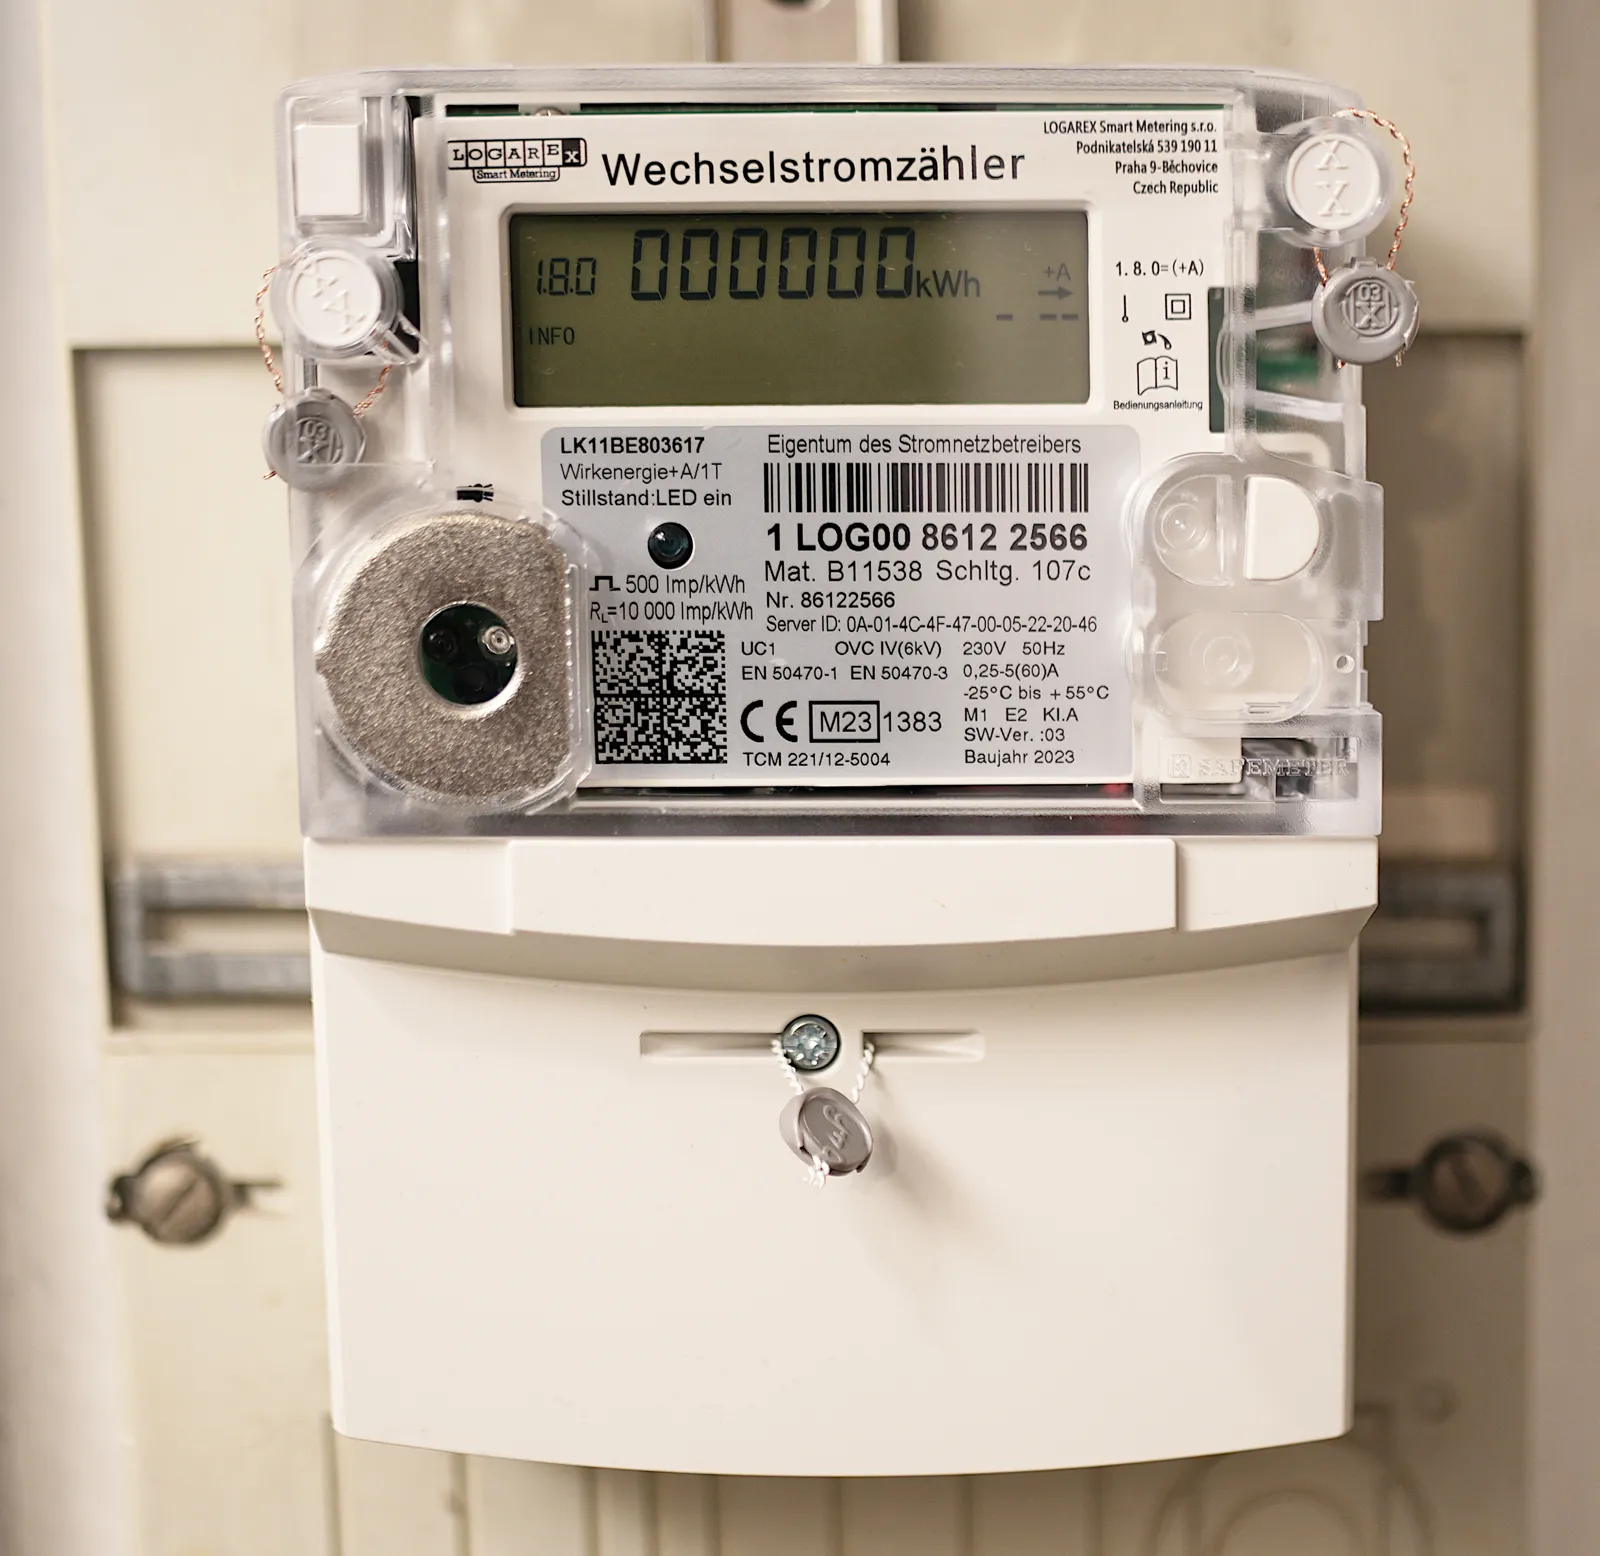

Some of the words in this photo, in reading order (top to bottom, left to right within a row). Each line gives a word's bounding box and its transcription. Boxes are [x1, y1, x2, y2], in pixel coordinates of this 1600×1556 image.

[1043, 119, 1097, 134] LOGAREX
[1099, 120, 1133, 133] Smart
[1136, 119, 1188, 136] Metering
[1190, 121, 1217, 133] s.r.o.
[1076, 139, 1155, 155] Podnikatelská
[1157, 138, 1178, 154] 539
[1180, 138, 1201, 153] 190
[1204, 138, 1218, 153] 11
[475, 168, 508, 180] Smart
[509, 168, 557, 181] Metering
[602, 145, 1026, 187] Wechselstromzähler
[1115, 160, 1147, 175] Praha
[1150, 159, 1219, 174] 9-Běchovice
[1133, 180, 1167, 195] Czech
[1169, 179, 1219, 197] Republic
[630, 227, 916, 301] 000000
[915, 268, 981, 299] kWh
[1042, 261, 1072, 282] +A
[1172, 258, 1204, 278] (+A)
[1358, 283, 1383, 302] 03
[528, 326, 576, 346] INFO
[1113, 400, 1204, 412] Bedienungsanleitung
[560, 436, 706, 454] LK11BE803617
[767, 433, 852, 458] Eigentum
[858, 433, 893, 454] des
[898, 432, 1082, 455] Stromnetzbetreibers
[560, 462, 723, 485] Wirkenergie+A/1T
[561, 489, 698, 507] Stillstand:LED
[703, 492, 733, 507] ein
[766, 523, 782, 551] 1
[796, 522, 911, 552] LOG00
[921, 522, 998, 552] 8612
[1009, 522, 1089, 552] 2566
[764, 560, 817, 583] Mat.
[827, 559, 924, 583] B11538
[935, 558, 1020, 587] Schltg.
[1031, 558, 1092, 582] 107c
[625, 574, 660, 594] 500
[665, 574, 746, 599] Imp/kWh
[765, 591, 795, 609] Nr.
[799, 590, 896, 609] 86122566
[643, 600, 676, 621] 000
[680, 600, 754, 626] Imp/kWh
[765, 615, 817, 633] Server
[820, 615, 842, 633] ID:
[845, 614, 1098, 634] 0A-01-4C-4F-47-00-05-22-20-46
[740, 640, 776, 656] UC1
[834, 640, 875, 656] OVC
[880, 640, 943, 660] IV(6kV)
[962, 640, 1007, 656] 230V
[1021, 640, 1066, 656] 50Hz
[741, 665, 768, 681] EN
[771, 665, 838, 681] 50470-1
[850, 664, 876, 680] EN
[880, 665, 949, 681] 50470-3
[962, 663, 1060, 682] 0,25-5(60)A
[1018, 685, 1042, 700] bis
[819, 710, 874, 733] M23
[882, 710, 943, 733] 1383
[963, 707, 988, 722] M1
[1004, 707, 1029, 722] E2
[963, 727, 1034, 742] SW-Ver.
[742, 752, 783, 767] TCM
[787, 752, 892, 767] 221/12-5004
[963, 749, 1029, 767] Baujahr
[1033, 749, 1076, 764] 2023
